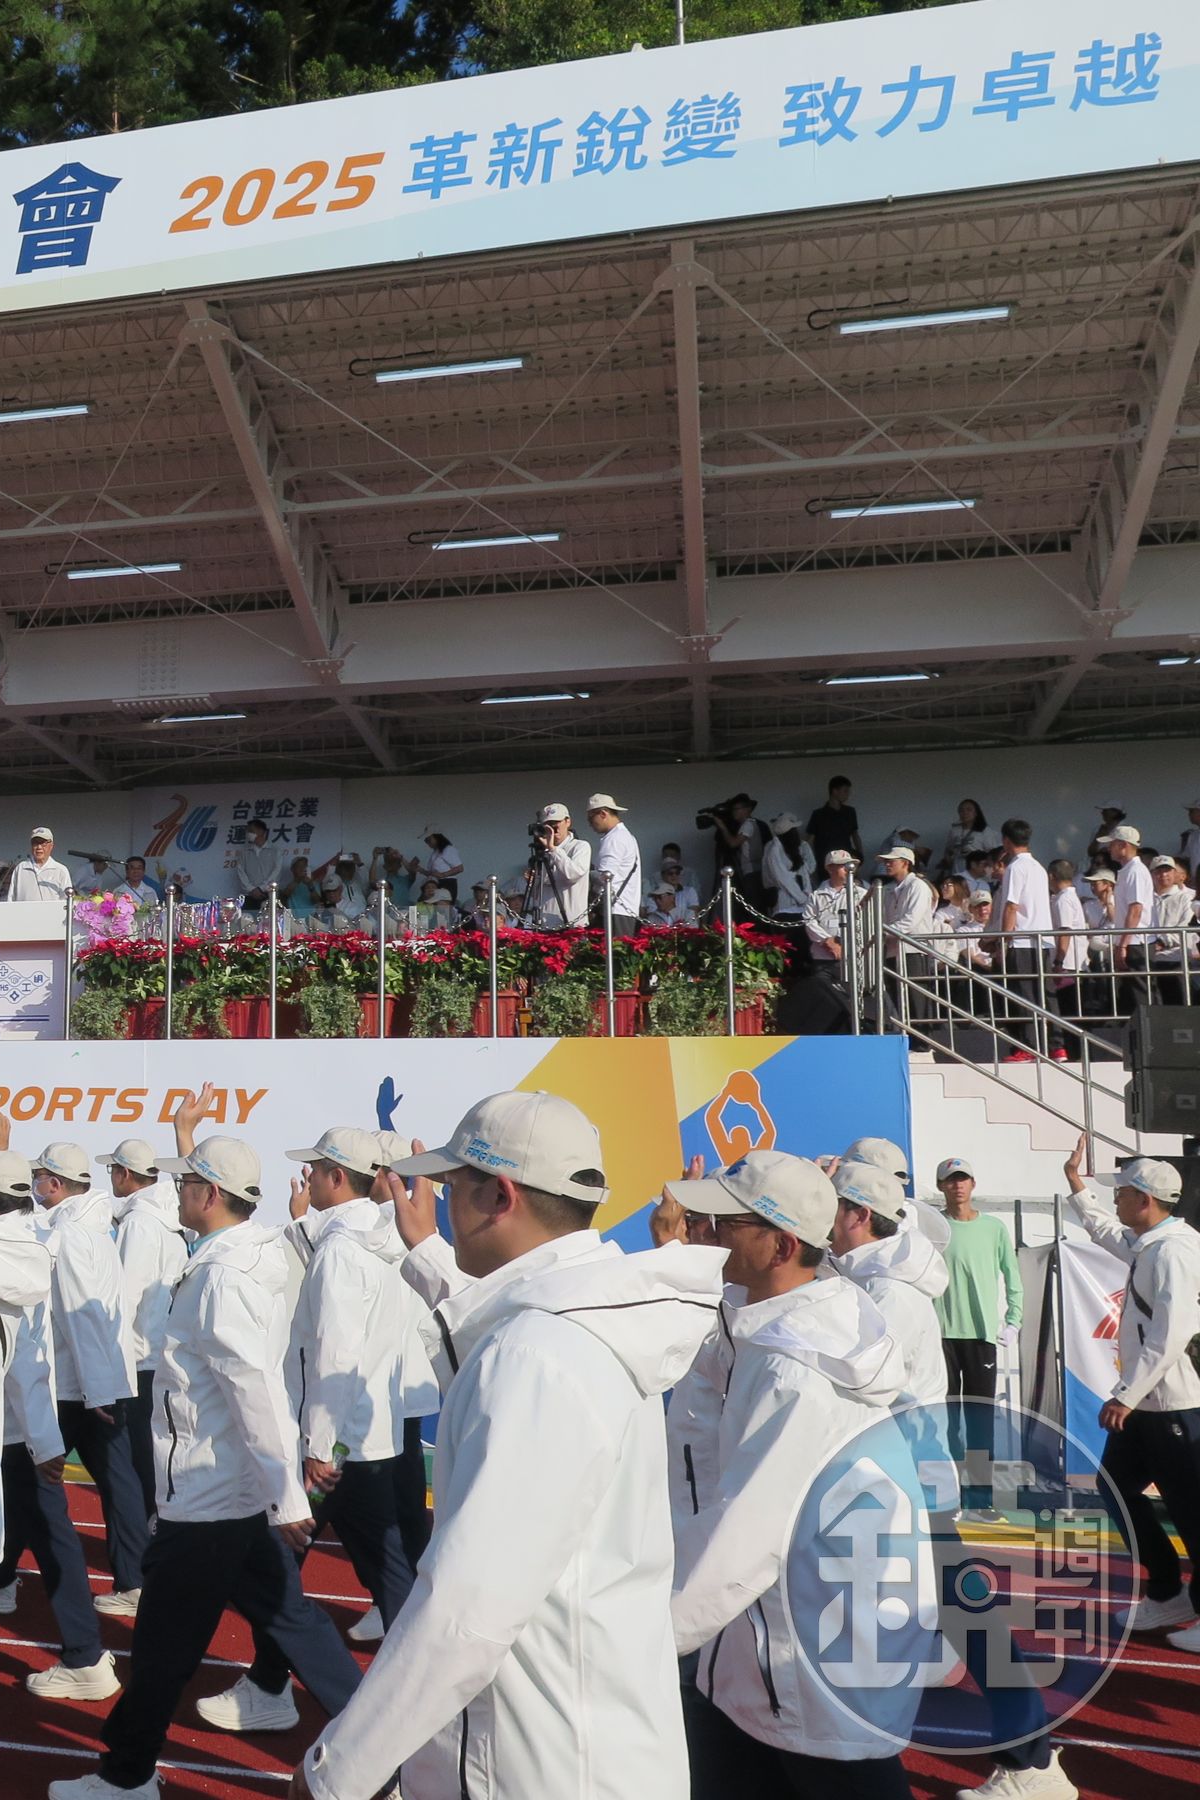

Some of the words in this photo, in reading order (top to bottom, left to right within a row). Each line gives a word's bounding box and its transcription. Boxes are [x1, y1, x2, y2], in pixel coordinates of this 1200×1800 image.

[168, 152, 386, 233] 2025
[402, 91, 742, 200] 革新銳變
[778, 32, 1163, 148] 致力卓越
[232, 797, 319, 820] 台塑企業
[226, 822, 315, 845] 運大會
[157, 1088, 269, 1124] DAY
[752, 1200, 775, 1215] FPG
